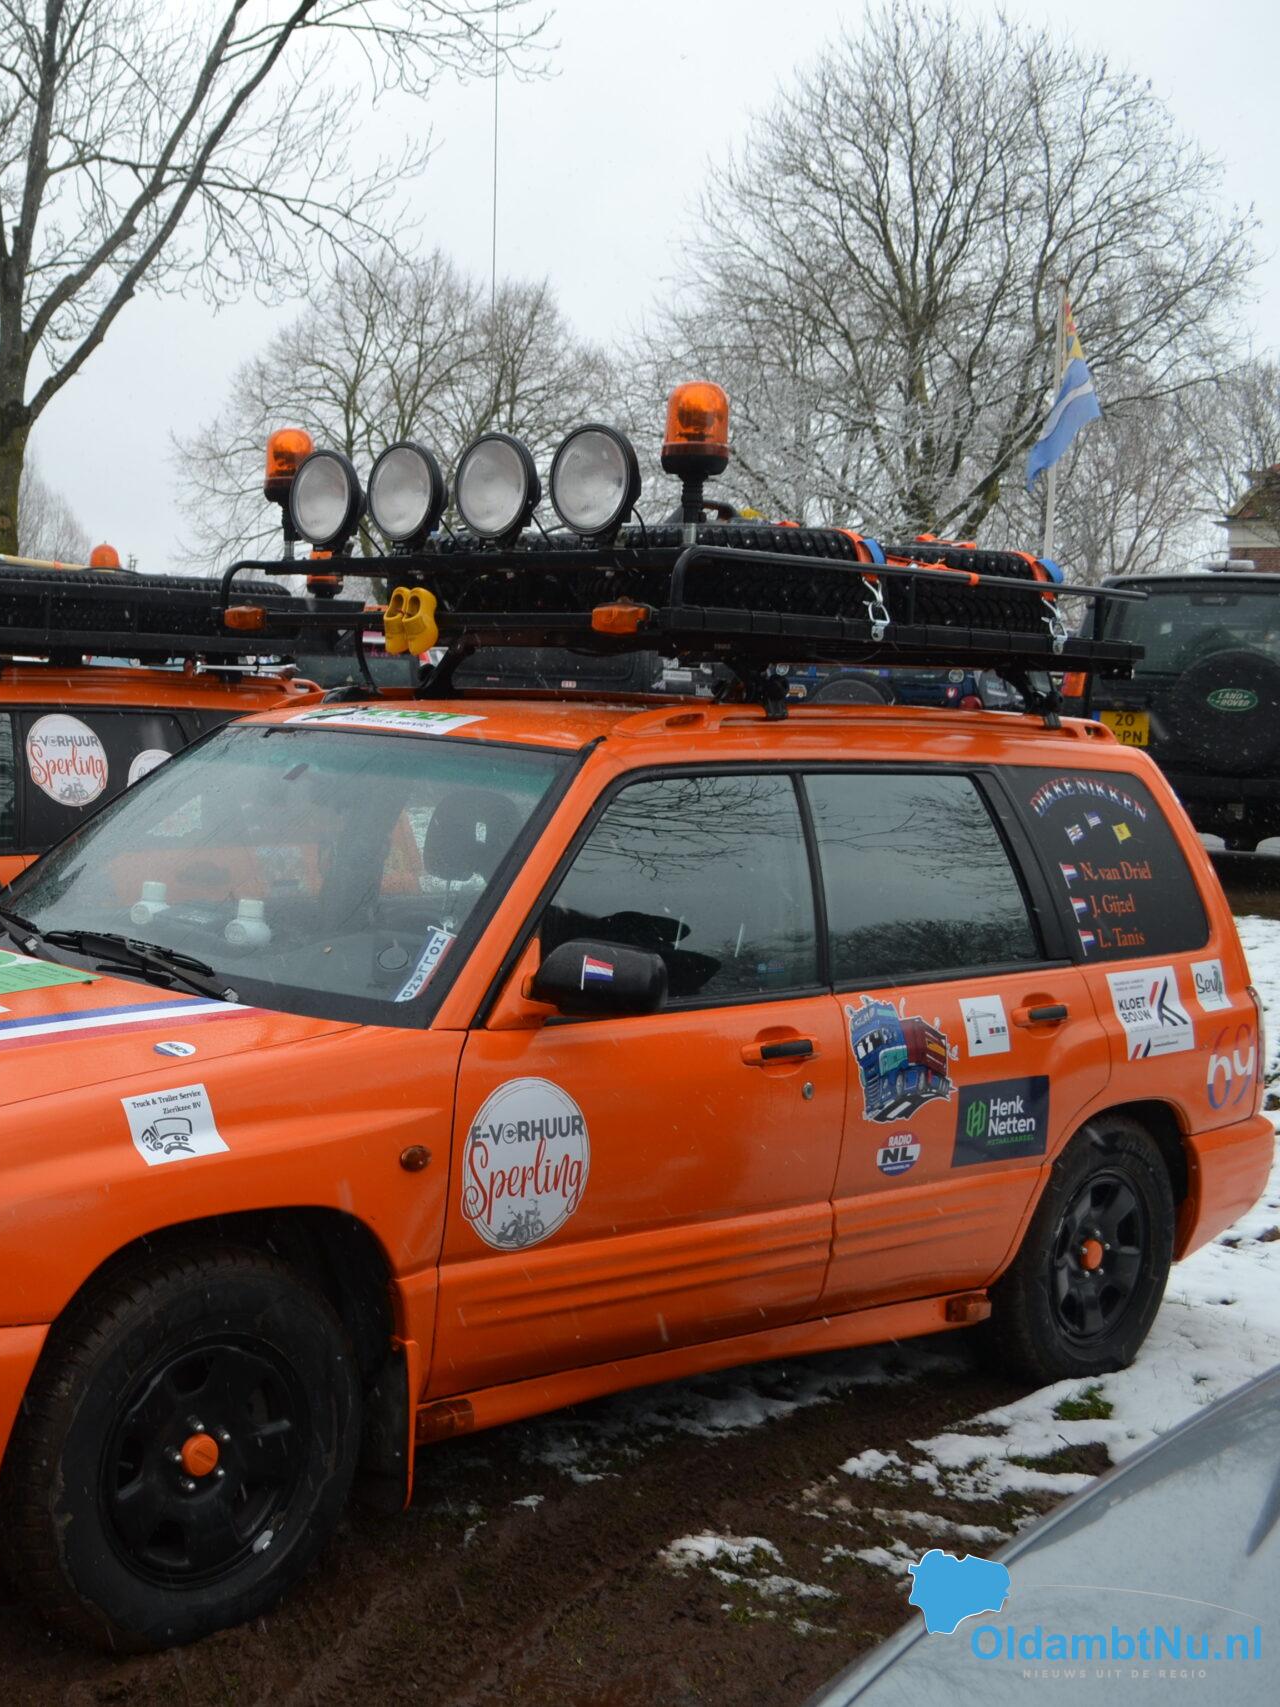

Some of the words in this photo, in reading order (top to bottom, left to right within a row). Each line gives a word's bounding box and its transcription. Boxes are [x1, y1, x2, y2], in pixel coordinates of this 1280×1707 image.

[1114, 713, 1135, 727] 20
[30, 743, 108, 788] Sperling
[1097, 928, 1111, 948] L.
[1112, 927, 1145, 947] Tanis
[402, 936, 447, 998] HOLLAND
[1118, 996, 1145, 1011] KLOET
[1122, 1009, 1152, 1023] BOUW
[132, 1100, 151, 1109] Truck
[158, 1095, 178, 1104] Trailer
[180, 1090, 202, 1099] Service
[163, 1103, 191, 1114] Zierikzee
[193, 1101, 202, 1109] BV
[989, 1095, 1024, 1118] Henk
[987, 1117, 1036, 1137] Netten
[888, 1133, 913, 1147] RADIO
[881, 1146, 914, 1164] NL
[462, 1137, 583, 1225] Sperling
